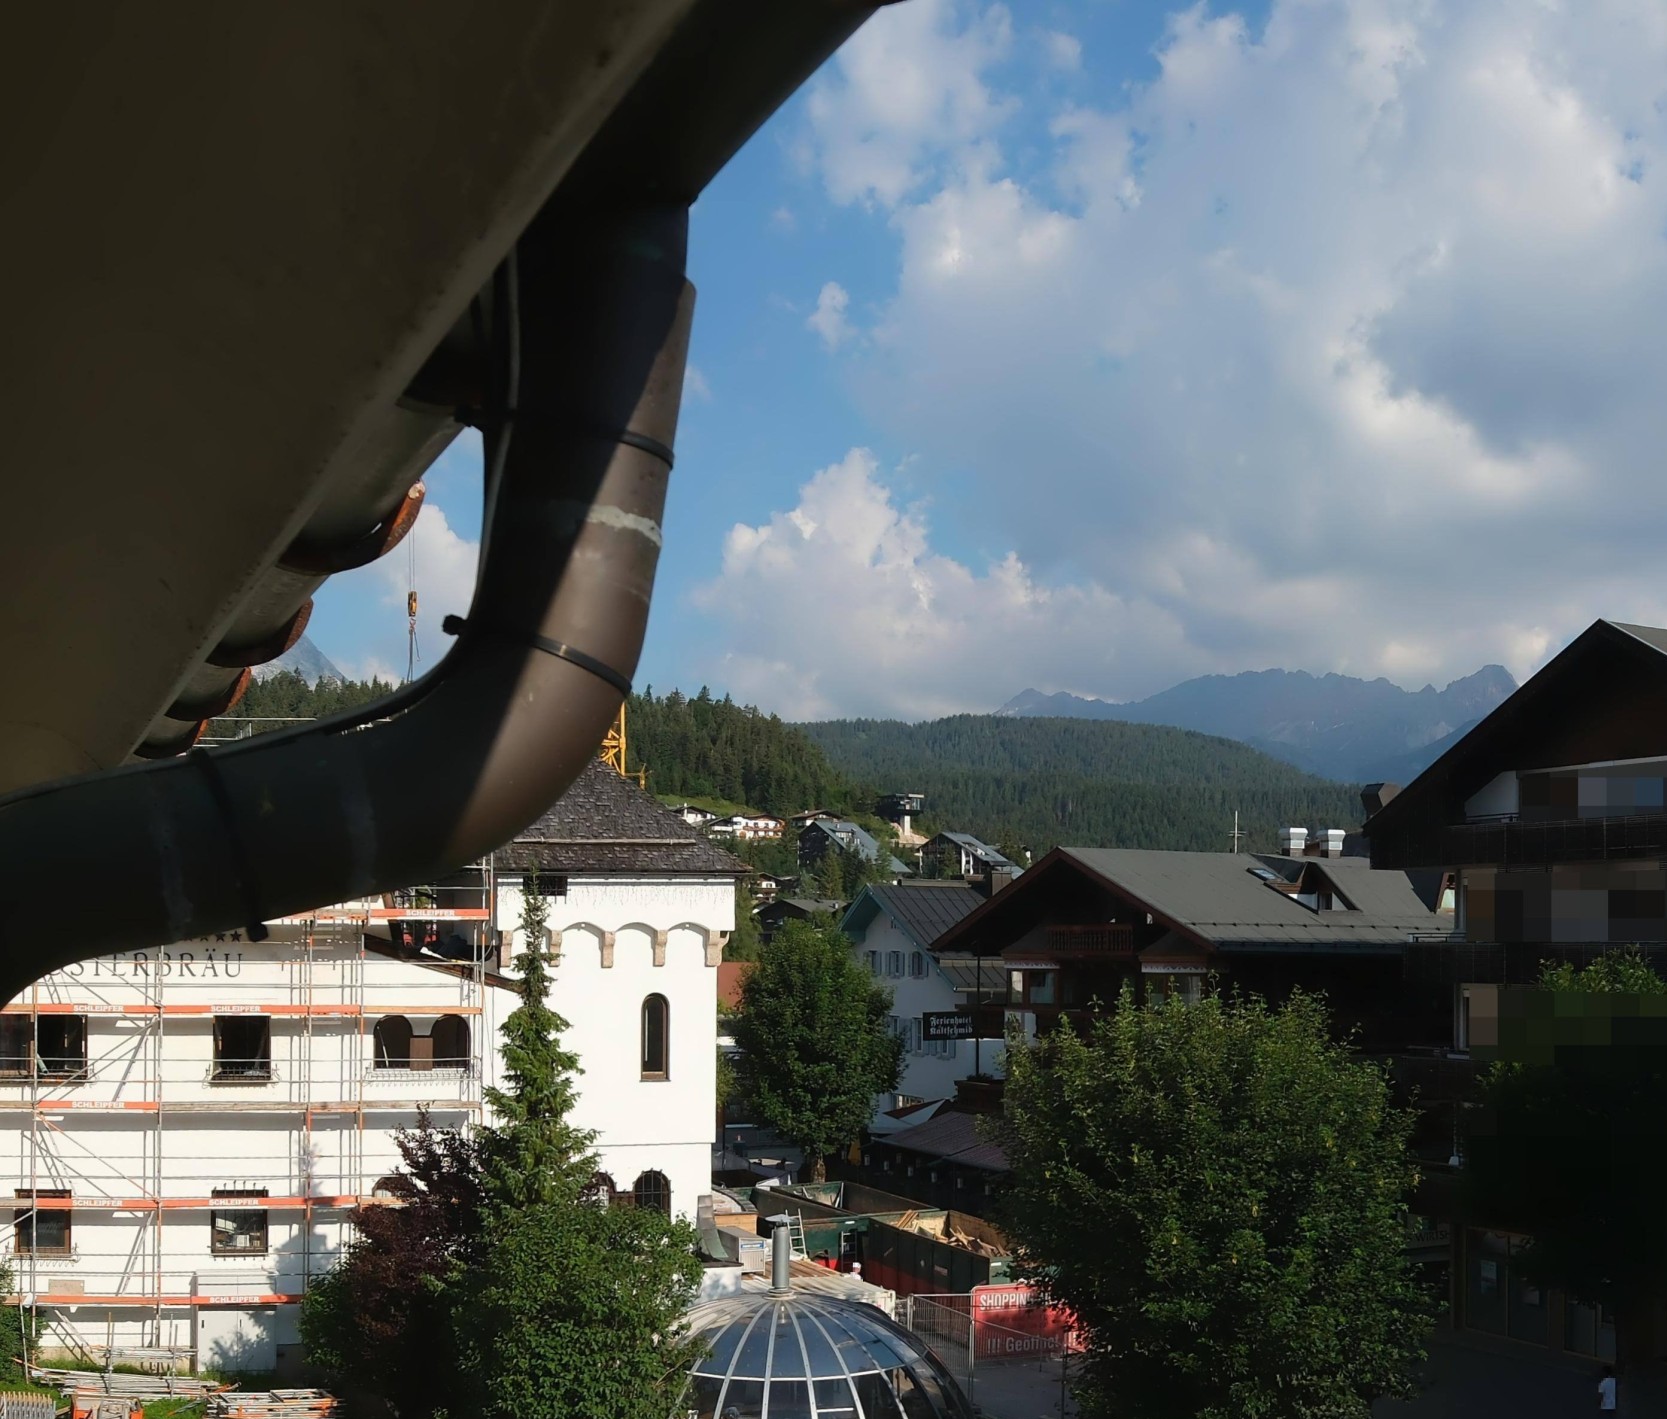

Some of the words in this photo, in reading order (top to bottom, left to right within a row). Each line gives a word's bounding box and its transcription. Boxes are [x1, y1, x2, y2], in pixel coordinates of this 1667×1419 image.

[405, 909, 455, 917] SCHLEIPFER
[48, 949, 243, 979] STERBRÄU
[73, 1005, 124, 1013] SCHLEIPFER
[210, 1005, 261, 1013] SCHLEIPFER
[71, 1101, 125, 1109] SCHLEIPFER
[72, 1199, 123, 1207] SCHLEIPFER
[209, 1199, 259, 1207] SCHLEIPFER
[209, 1296, 260, 1304] SCHLEIPFER
